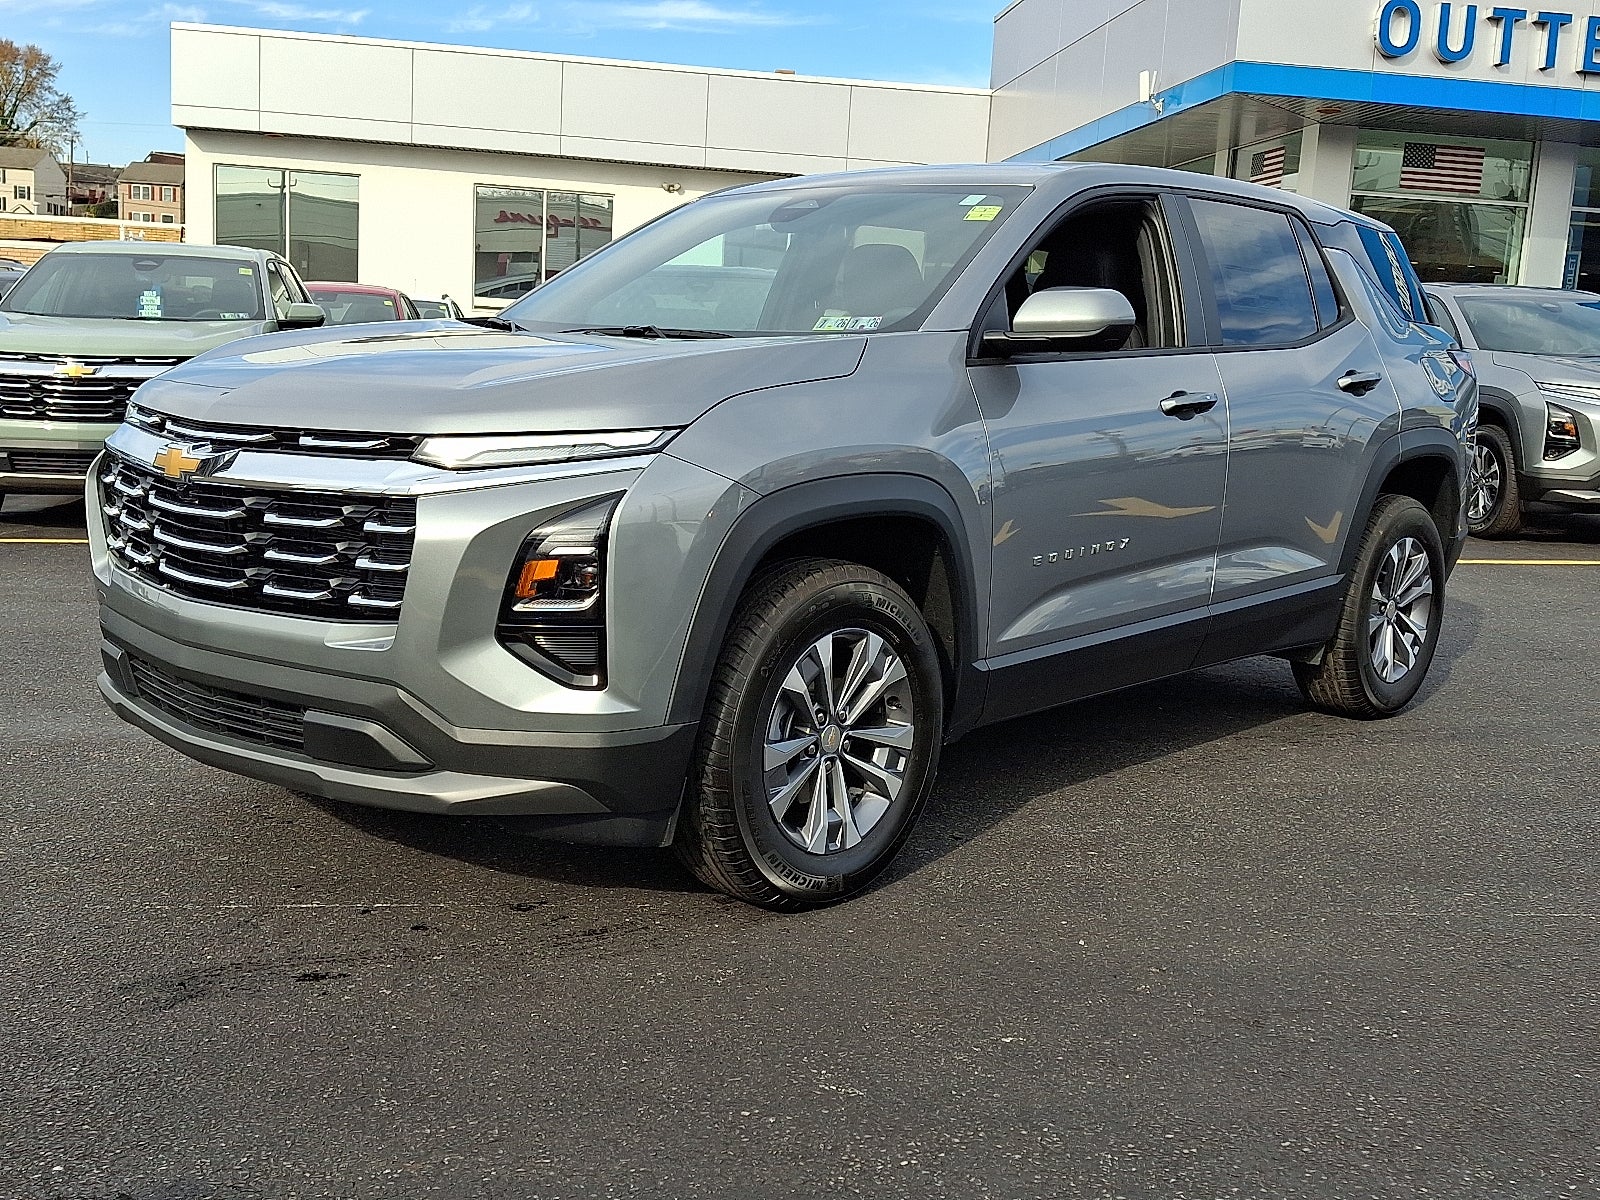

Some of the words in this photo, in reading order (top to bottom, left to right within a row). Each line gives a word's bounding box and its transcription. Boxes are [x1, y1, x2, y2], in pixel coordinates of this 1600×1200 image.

[1032, 538, 1130, 566] EQUINOX
[875, 597, 920, 641] MICHELIN
[766, 853, 825, 890] MICHELIN
